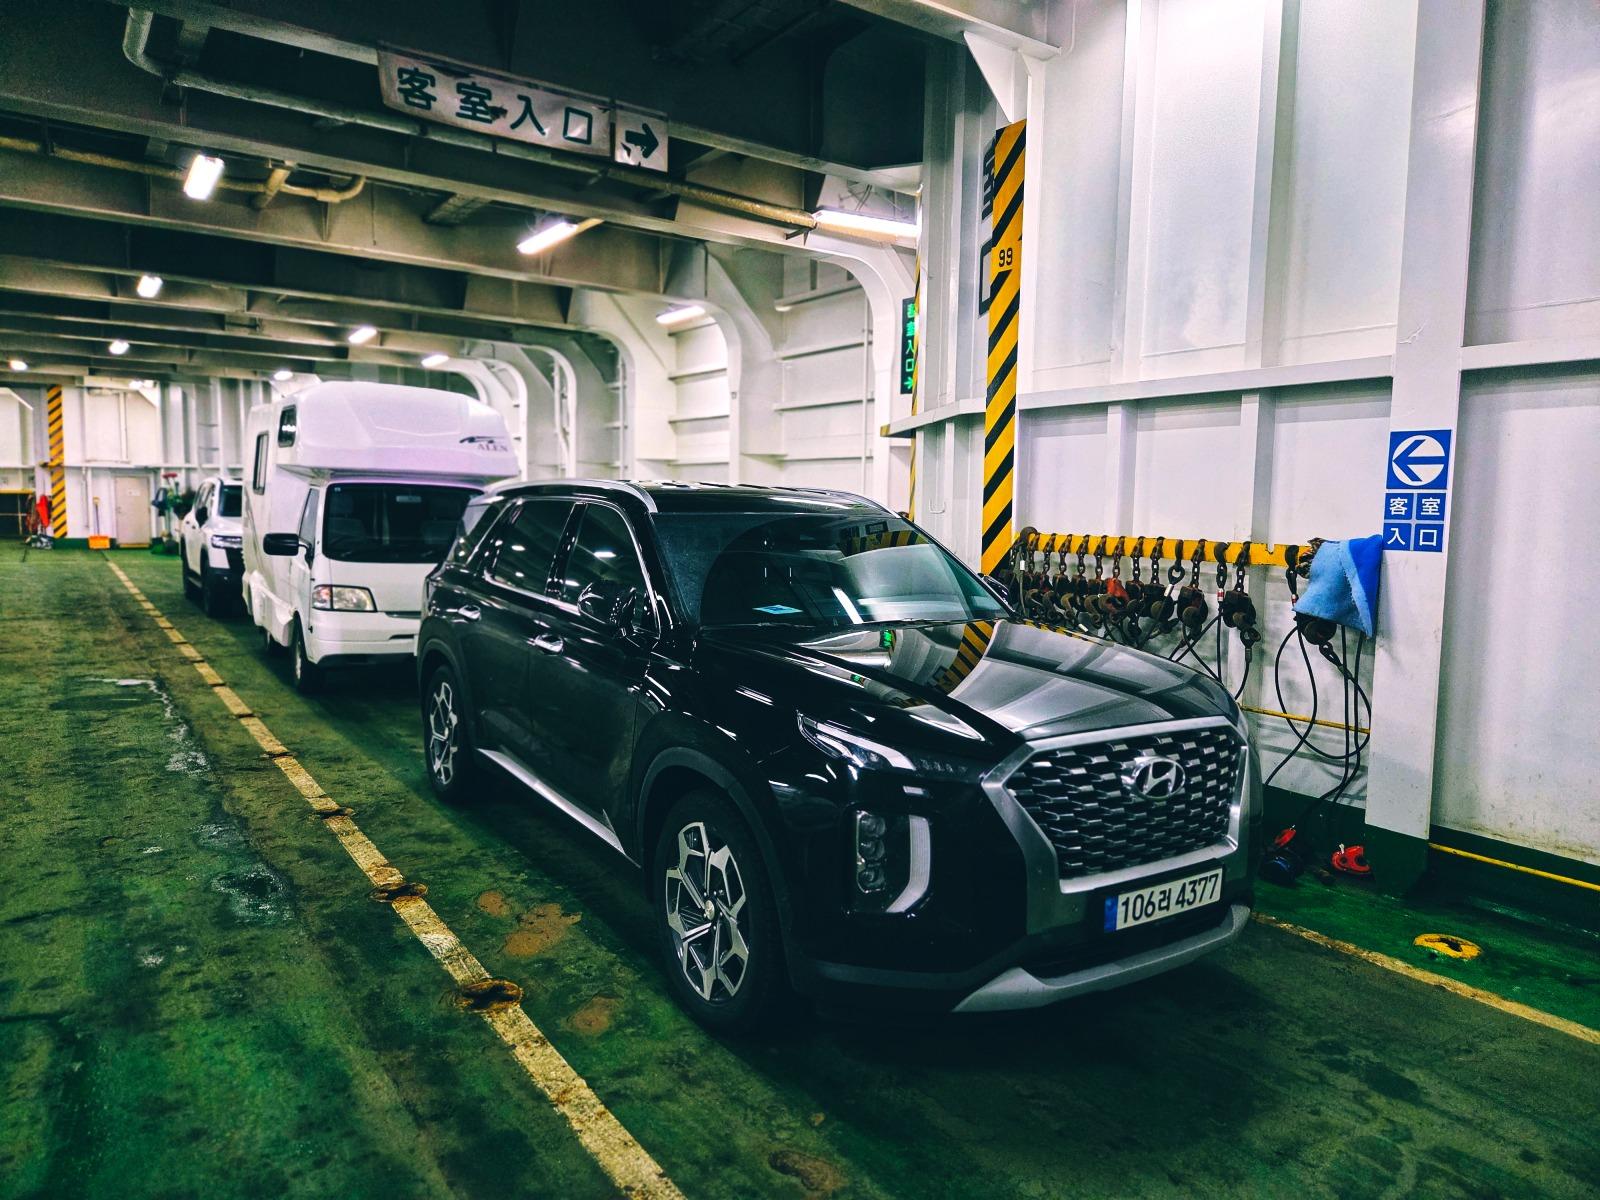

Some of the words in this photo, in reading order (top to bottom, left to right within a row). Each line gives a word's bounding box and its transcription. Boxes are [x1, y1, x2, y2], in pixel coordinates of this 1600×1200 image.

[397, 66, 593, 145] 客室入口
[998, 247, 1013, 267] 99
[1389, 497, 1440, 516] 客室
[1387, 527, 1438, 547] 入口
[1121, 887, 1172, 924] 106러
[1174, 873, 1220, 909] 4377
